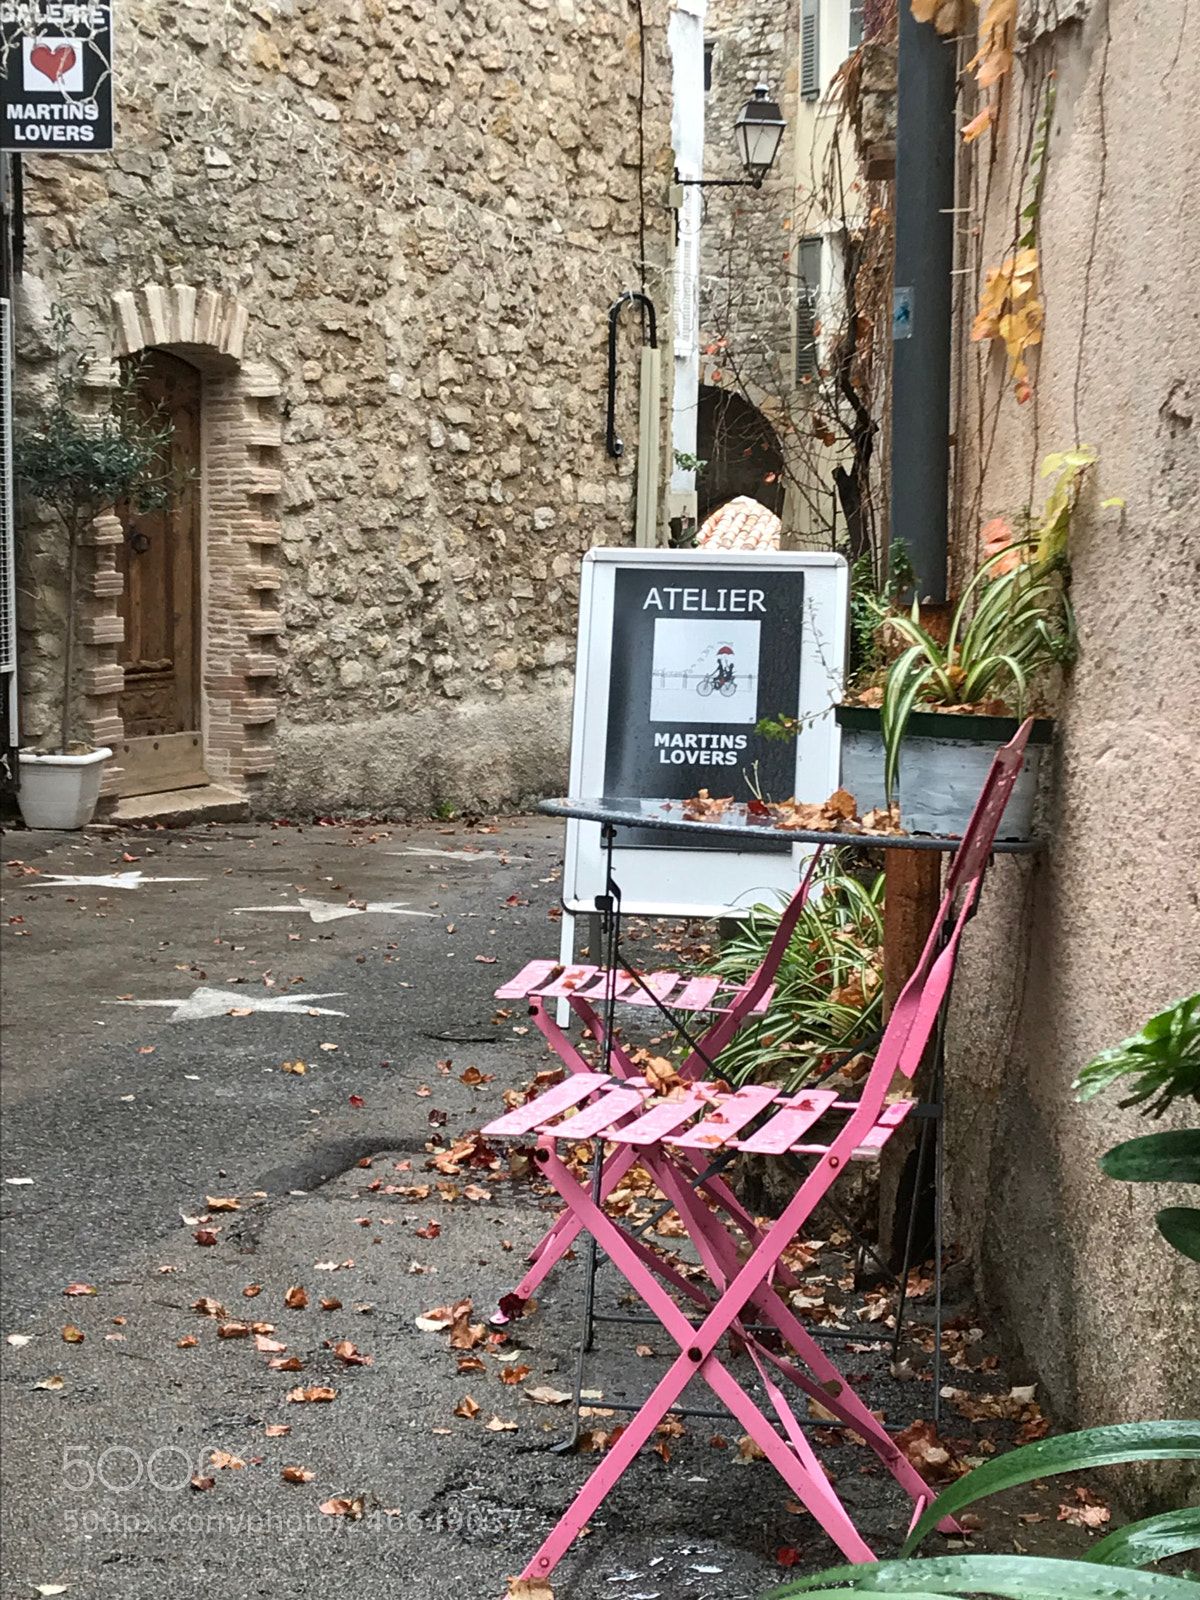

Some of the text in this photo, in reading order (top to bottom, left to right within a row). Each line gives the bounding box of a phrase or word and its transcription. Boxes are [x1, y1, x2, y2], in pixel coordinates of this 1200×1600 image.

[7, 103, 99, 120] MARTINS
[14, 124, 95, 141] LOVERS
[643, 587, 767, 612] ATELIER
[654, 732, 747, 749] MARTINS
[659, 749, 738, 765] LOVERS
